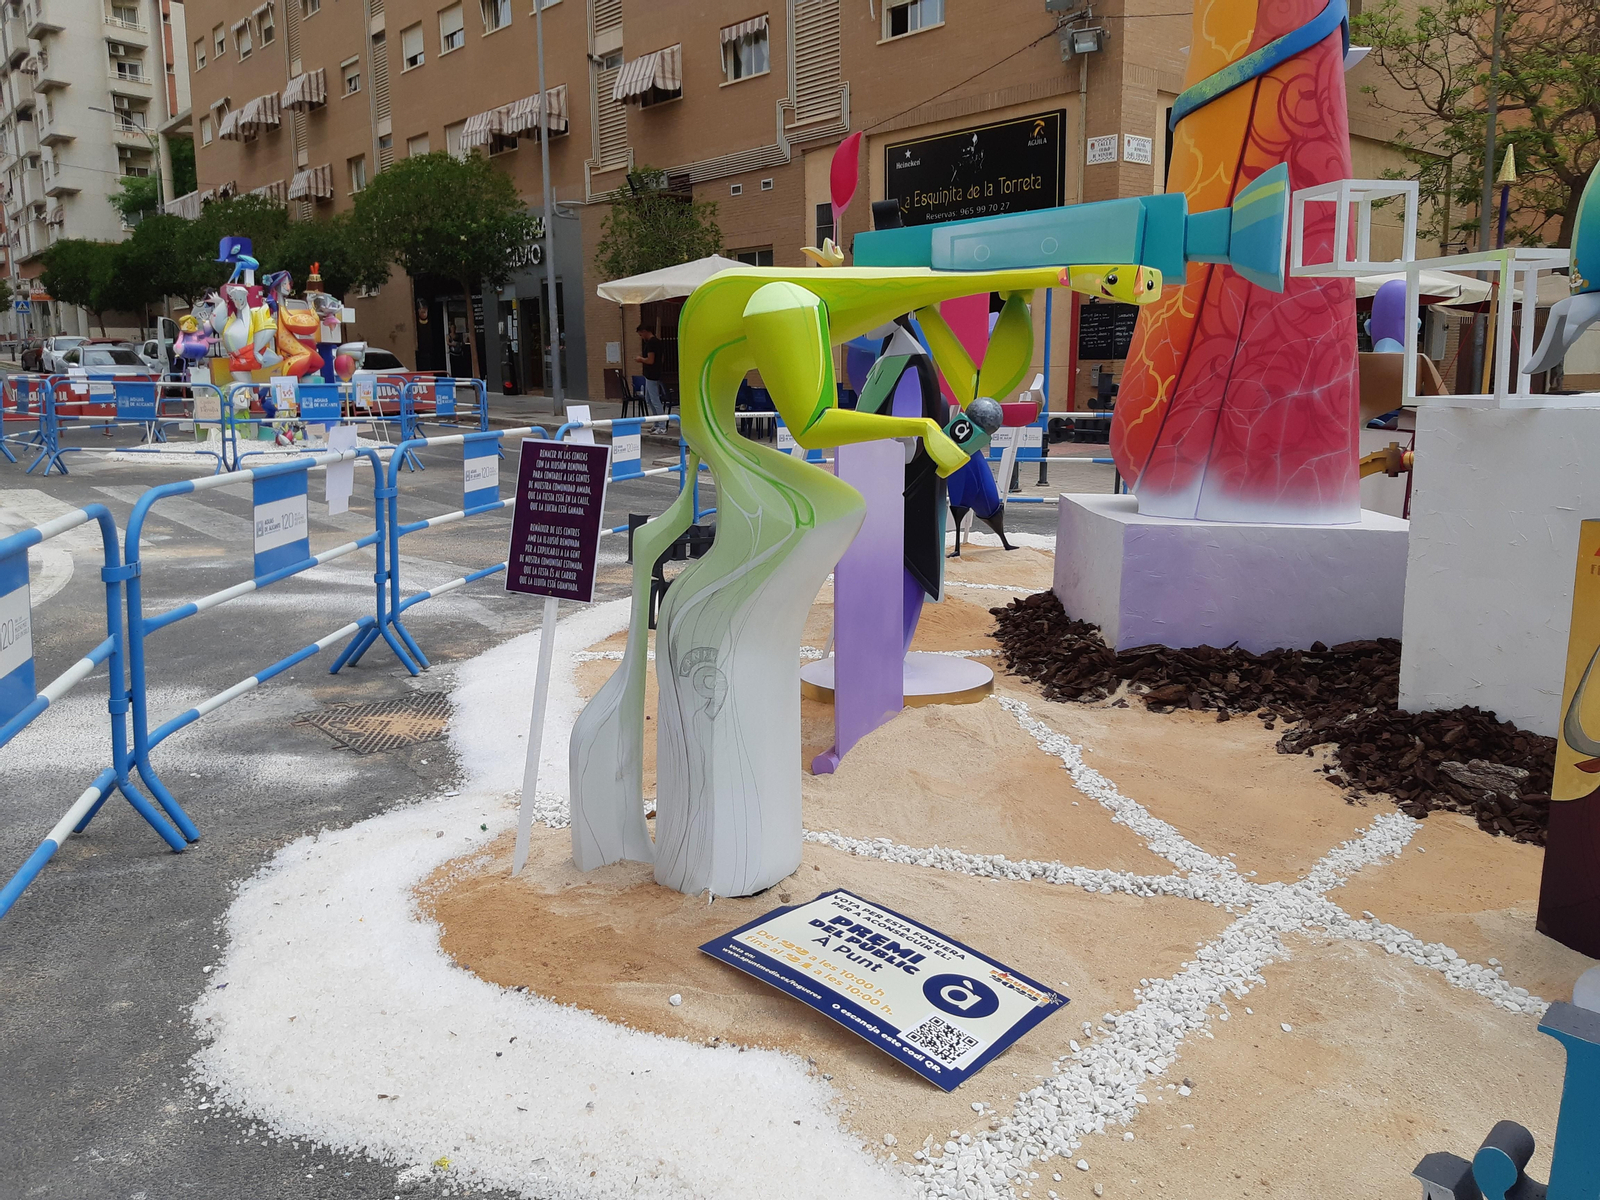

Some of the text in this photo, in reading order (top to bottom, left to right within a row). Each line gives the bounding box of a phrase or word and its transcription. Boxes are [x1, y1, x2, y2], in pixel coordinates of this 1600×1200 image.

[896, 158, 921, 170] Heineken
[915, 186, 962, 210] Esquinita
[967, 184, 980, 200] de
[984, 181, 993, 197] la
[998, 173, 1042, 195] Torreta
[925, 202, 1010, 221] Reservas: 965 99 70 27
[540, 449, 588, 461] RENACER DE LAS CENIZAS
[536, 460, 544, 468] CON
[532, 470, 543, 479] PARA
[544, 471, 563, 480] CONTARLE
[567, 473, 575, 482] LAS
[575, 474, 590, 483] GENTES
[528, 480, 534, 489] DE
[534, 481, 552, 490] NUESTRA
[552, 483, 576, 493] COMUNIDAD
[527, 491, 536, 500] QUE
[536, 492, 542, 500] LA
[542, 492, 555, 501] FIESTA
[565, 495, 571, 503] EN
[571, 495, 577, 504] LA
[530, 502, 538, 511] QUE
[538, 503, 544, 511] LA
[281, 512, 294, 530] 120
[550, 526, 555, 534] DE
[527, 534, 537, 542] AMB
[537, 535, 542, 543] LA
[560, 538, 580, 548] RENOVADA
[525, 544, 533, 553] PER
[564, 549, 570, 557] LA
[570, 550, 580, 559] GENT
[519, 554, 524, 562] DE
[525, 555, 541, 564] NOSTRA
[541, 557, 563, 567] COMUNITAT
[523, 565, 532, 575] QUE
[532, 567, 537, 575] LA
[538, 567, 549, 576] FESTA
[555, 570, 561, 578] AL
[561, 570, 577, 580] CARRER
[519, 576, 527, 585] QUE
[528, 577, 533, 585] LA
[0, 618, 14, 651] 20
[831, 902, 851, 912] PER
[863, 916, 932, 951] ACONSEGUIR
[934, 950, 951, 961] EL:
[833, 895, 966, 960] VOTA PER ESTA FOGUERA
[808, 919, 920, 975] DEL PÚBLIC
[828, 915, 926, 964] PREMI
[728, 944, 744, 954] Vota
[756, 930, 778, 942] Del
[819, 960, 839, 971] les
[839, 970, 874, 990] 10:00
[833, 945, 884, 972] Punt
[744, 935, 770, 948] fins
[824, 974, 844, 986] les
[844, 984, 880, 1006] 10:00
[840, 1008, 880, 1034] escaneja
[880, 1033, 902, 1048] este
[902, 1046, 924, 1061] codi
[923, 1060, 941, 1074] QR.
